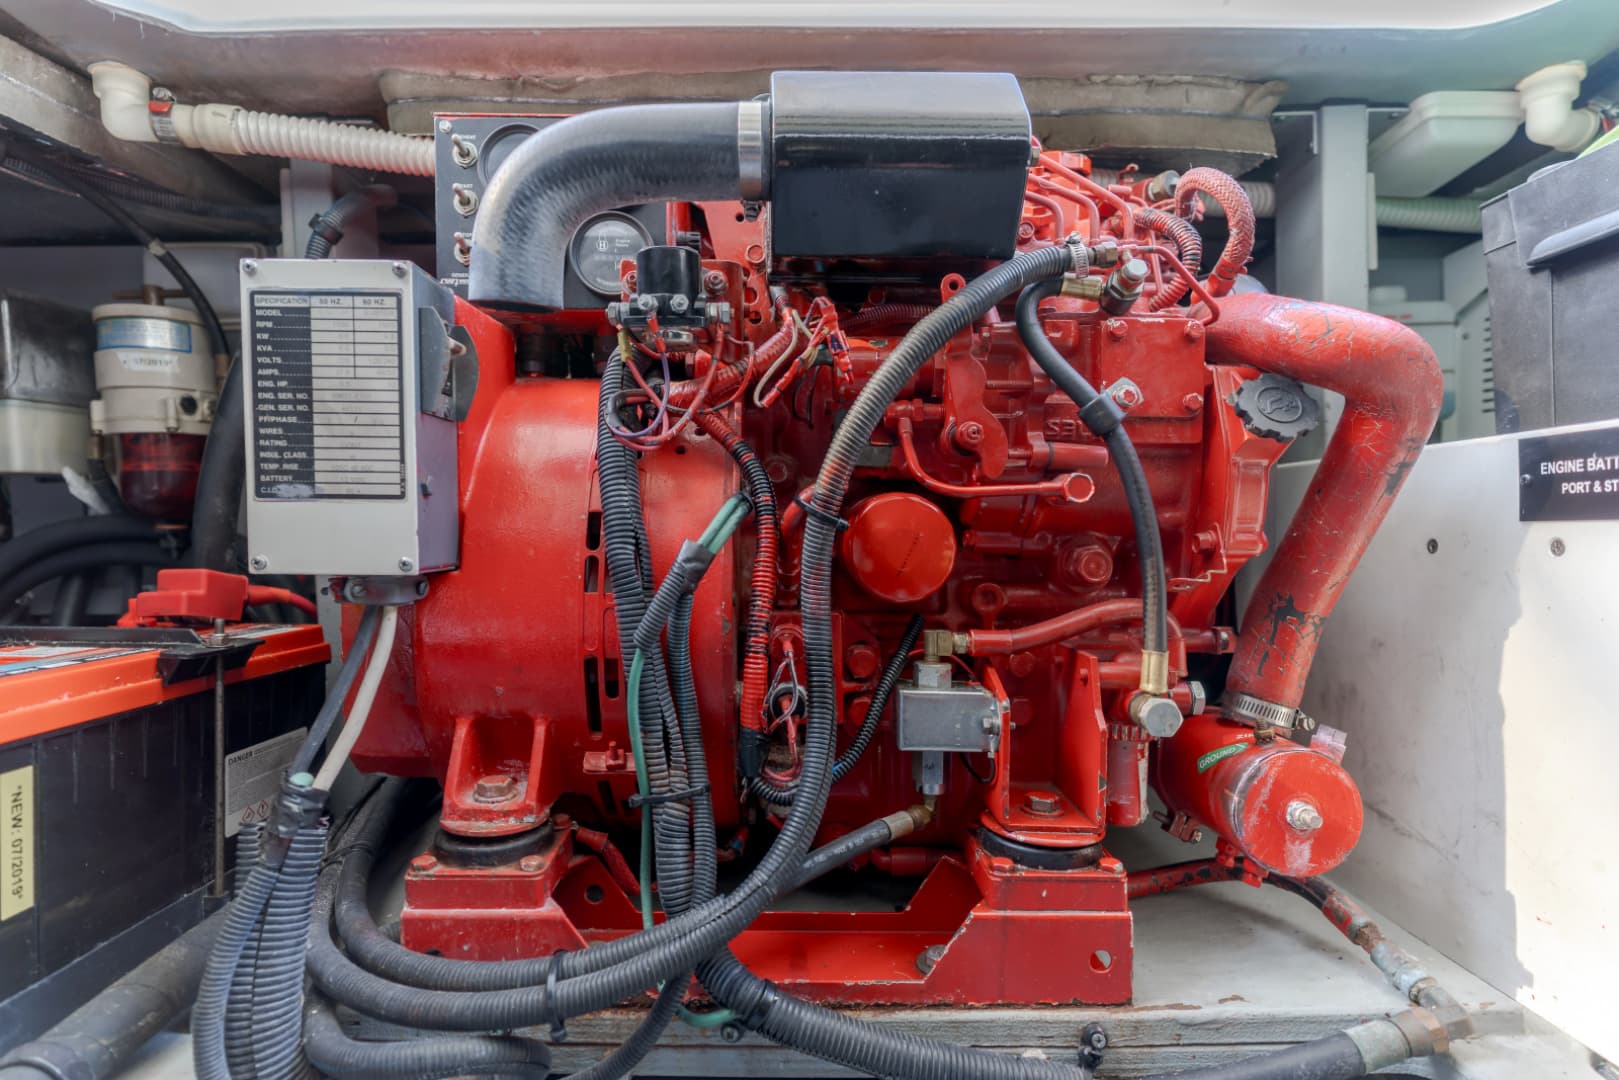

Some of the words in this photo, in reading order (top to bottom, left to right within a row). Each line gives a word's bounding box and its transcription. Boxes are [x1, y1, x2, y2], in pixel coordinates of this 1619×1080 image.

[1540, 459, 1584, 475] ENGINE
[1562, 481, 1591, 495] PORT
[1593, 480, 1602, 493] &
[228, 750, 254, 766] DANGER
[1199, 746, 1237, 769] GROUND
